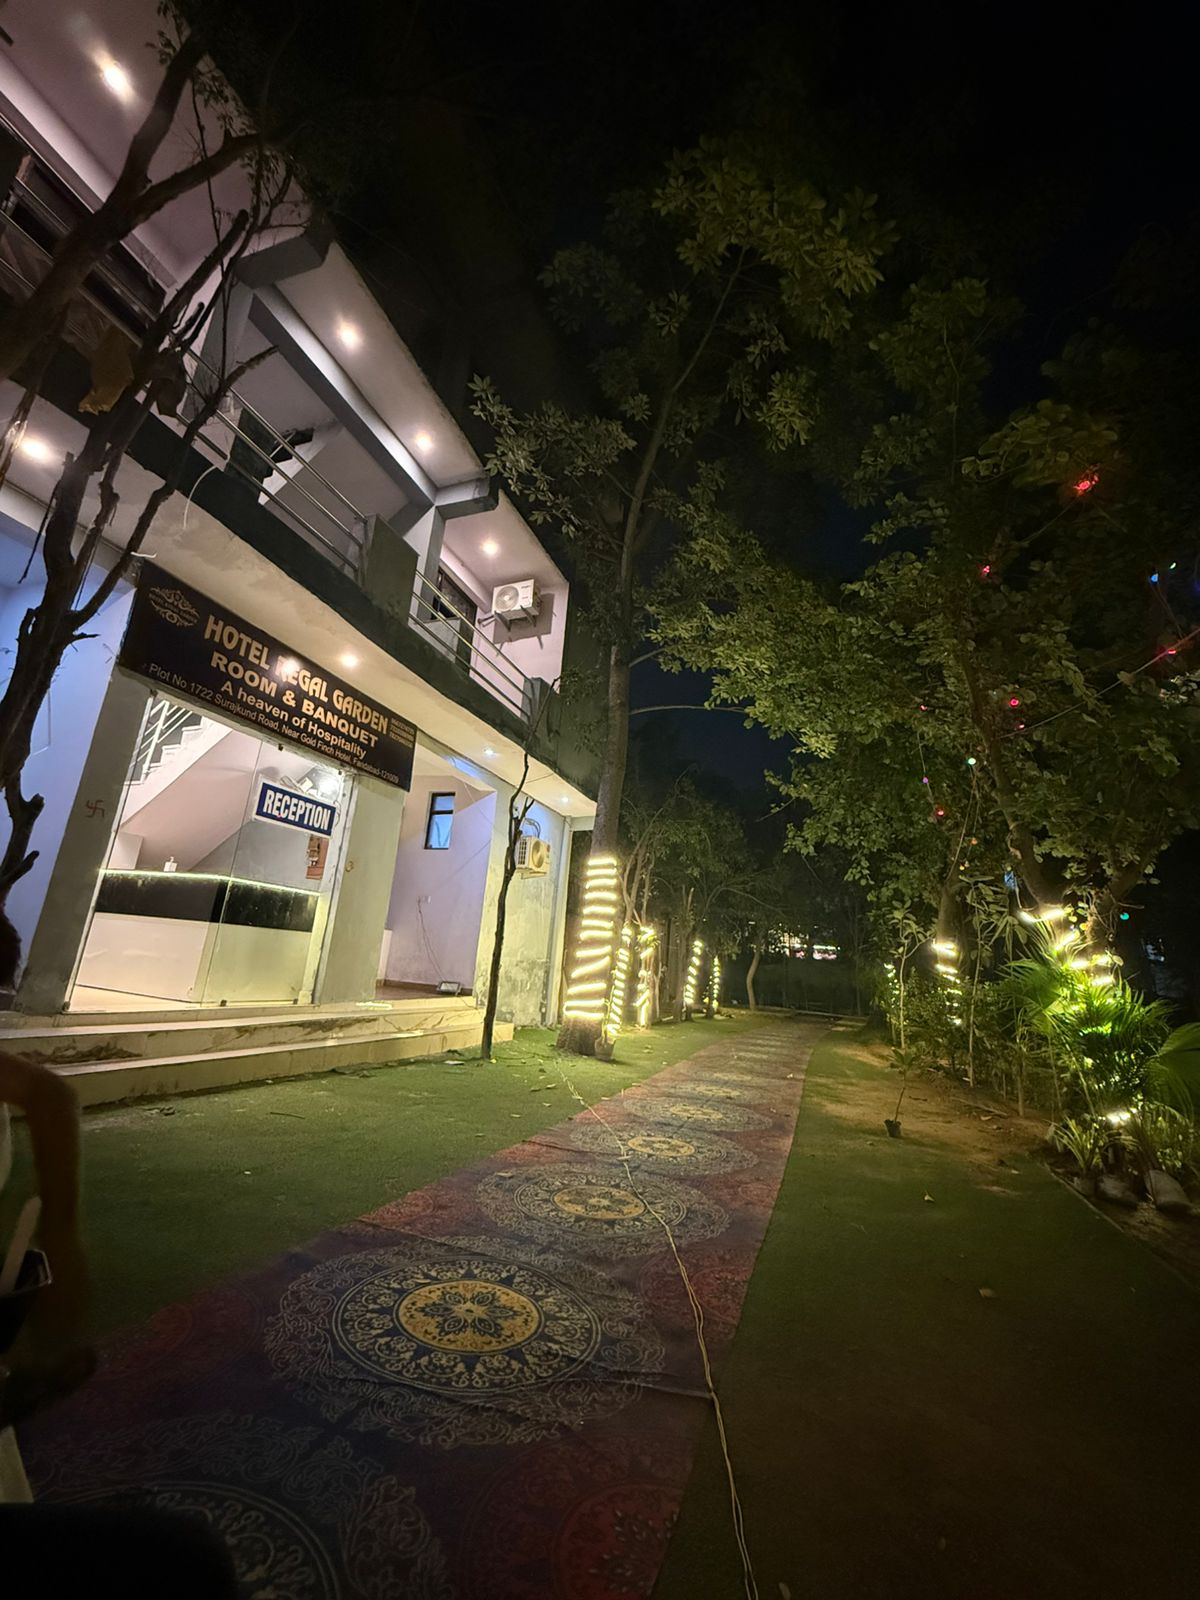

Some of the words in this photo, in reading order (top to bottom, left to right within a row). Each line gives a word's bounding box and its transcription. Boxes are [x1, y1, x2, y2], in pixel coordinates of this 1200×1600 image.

[149, 663, 170, 681] Plot
[190, 683, 214, 701] 1722
[215, 694, 257, 720] Surajkund
[282, 724, 300, 738] Near
[300, 733, 316, 747] Gold
[317, 740, 334, 754] Finch
[204, 614, 270, 670] HOTEL
[333, 689, 388, 735] GARDEN
[211, 651, 277, 697] ROOM
[282, 690, 296, 708] &
[302, 699, 378, 748] BANQUET
[221, 681, 233, 696] A
[238, 687, 288, 721] heaven
[292, 717, 307, 729] of
[308, 721, 366, 760] Hospitality
[263, 789, 332, 830] RECEPTION
